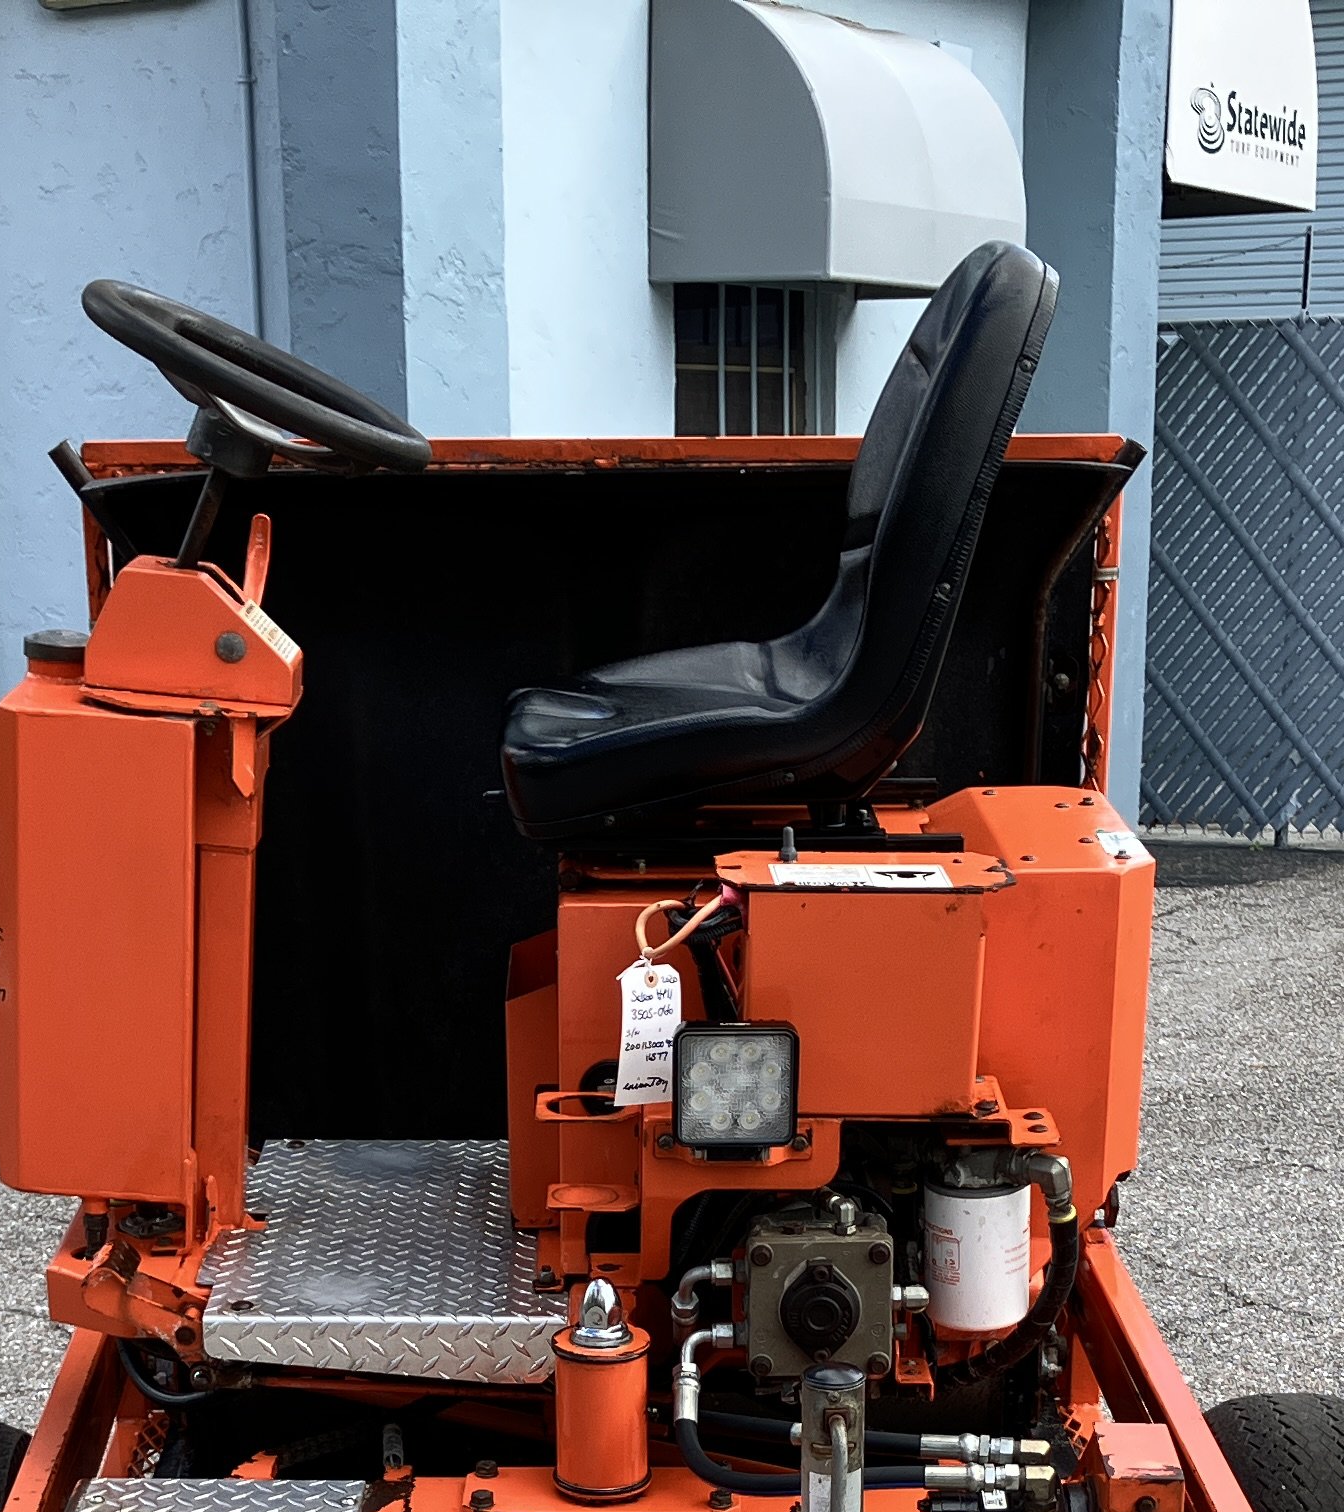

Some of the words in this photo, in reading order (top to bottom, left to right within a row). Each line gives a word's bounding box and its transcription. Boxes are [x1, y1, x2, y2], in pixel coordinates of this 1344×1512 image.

[1226, 90, 1306, 150] Statewide
[1230, 139, 1251, 155] TURF
[1255, 144, 1300, 168] EQUIPMENT
